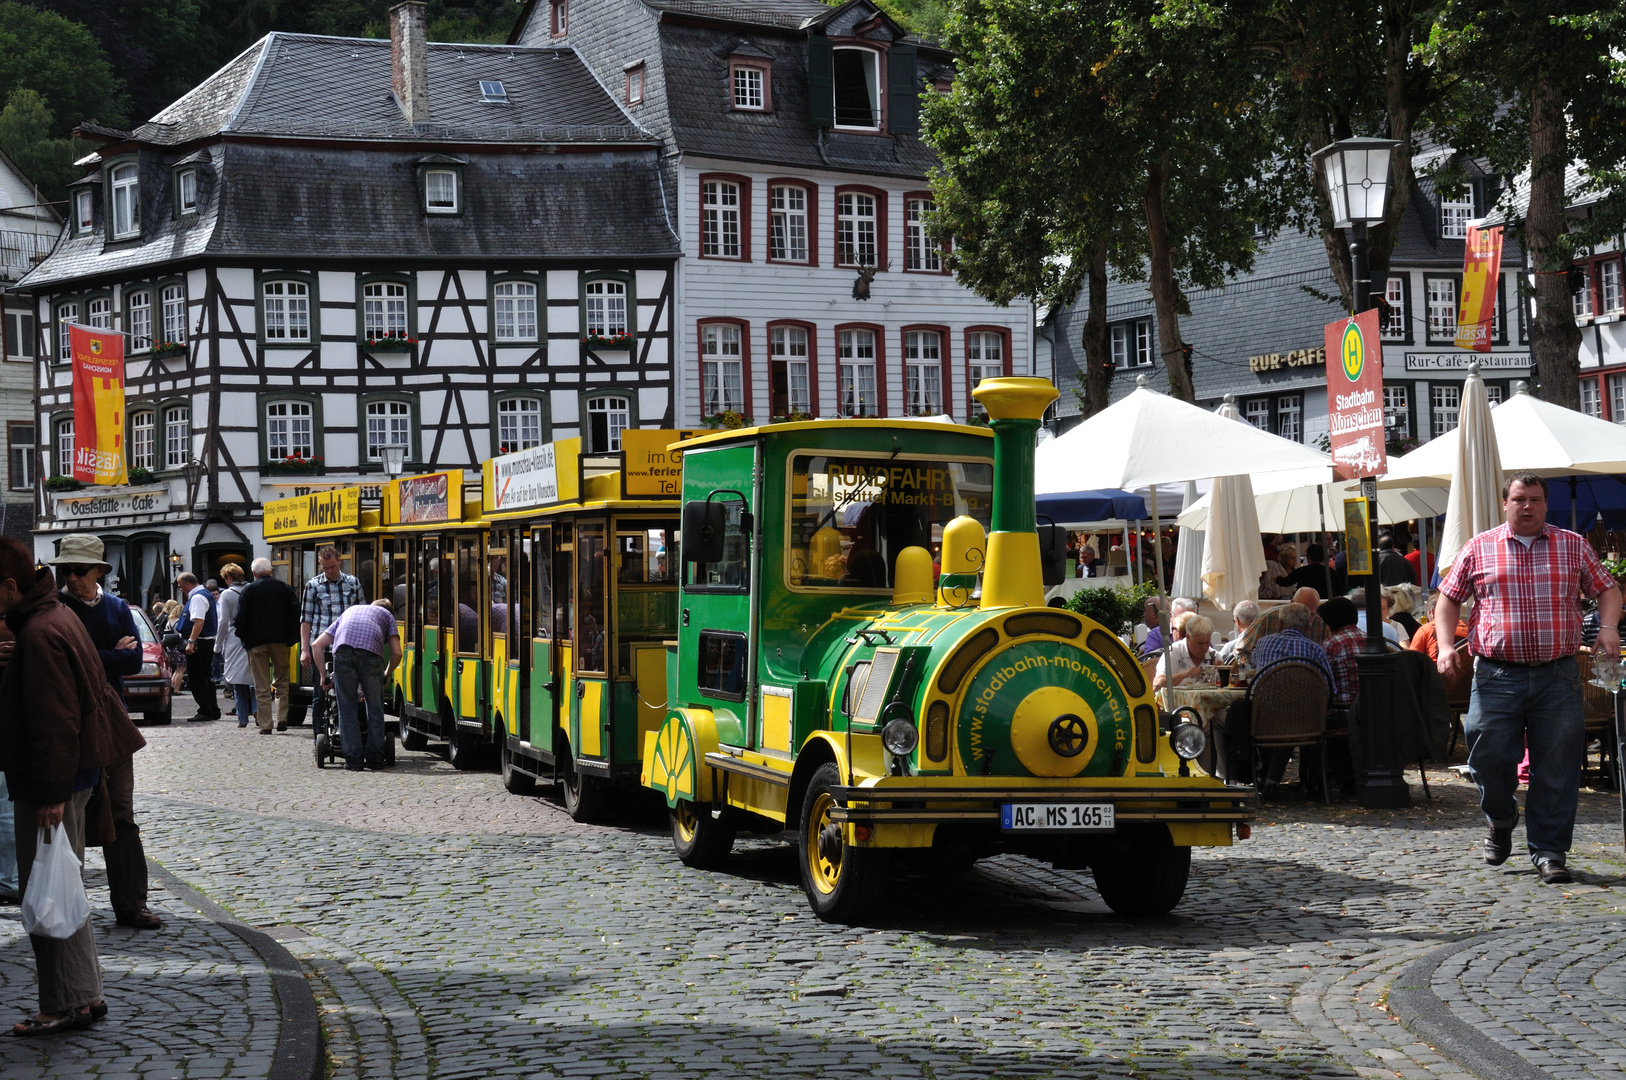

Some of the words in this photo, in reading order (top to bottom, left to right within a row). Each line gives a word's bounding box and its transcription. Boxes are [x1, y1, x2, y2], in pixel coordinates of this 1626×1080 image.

[1348, 338, 1358, 368] H
[1336, 388, 1375, 411] Stadtbahn
[1330, 406, 1382, 435] Monschau
[647, 450, 665, 463] im
[658, 481, 682, 493] Tel.
[828, 465, 960, 490] RUNDFAHRT
[71, 499, 119, 515] Gaststätte
[131, 494, 154, 511] Café
[308, 492, 342, 526] Markt
[274, 518, 282, 530] alle
[283, 517, 288, 528] 45
[289, 515, 298, 528] min.
[970, 656, 1126, 761] www.stadtbahn-monschau.de
[1015, 807, 1035, 826] AC
[1046, 807, 1067, 826] MS
[1072, 807, 1102, 826] 165
